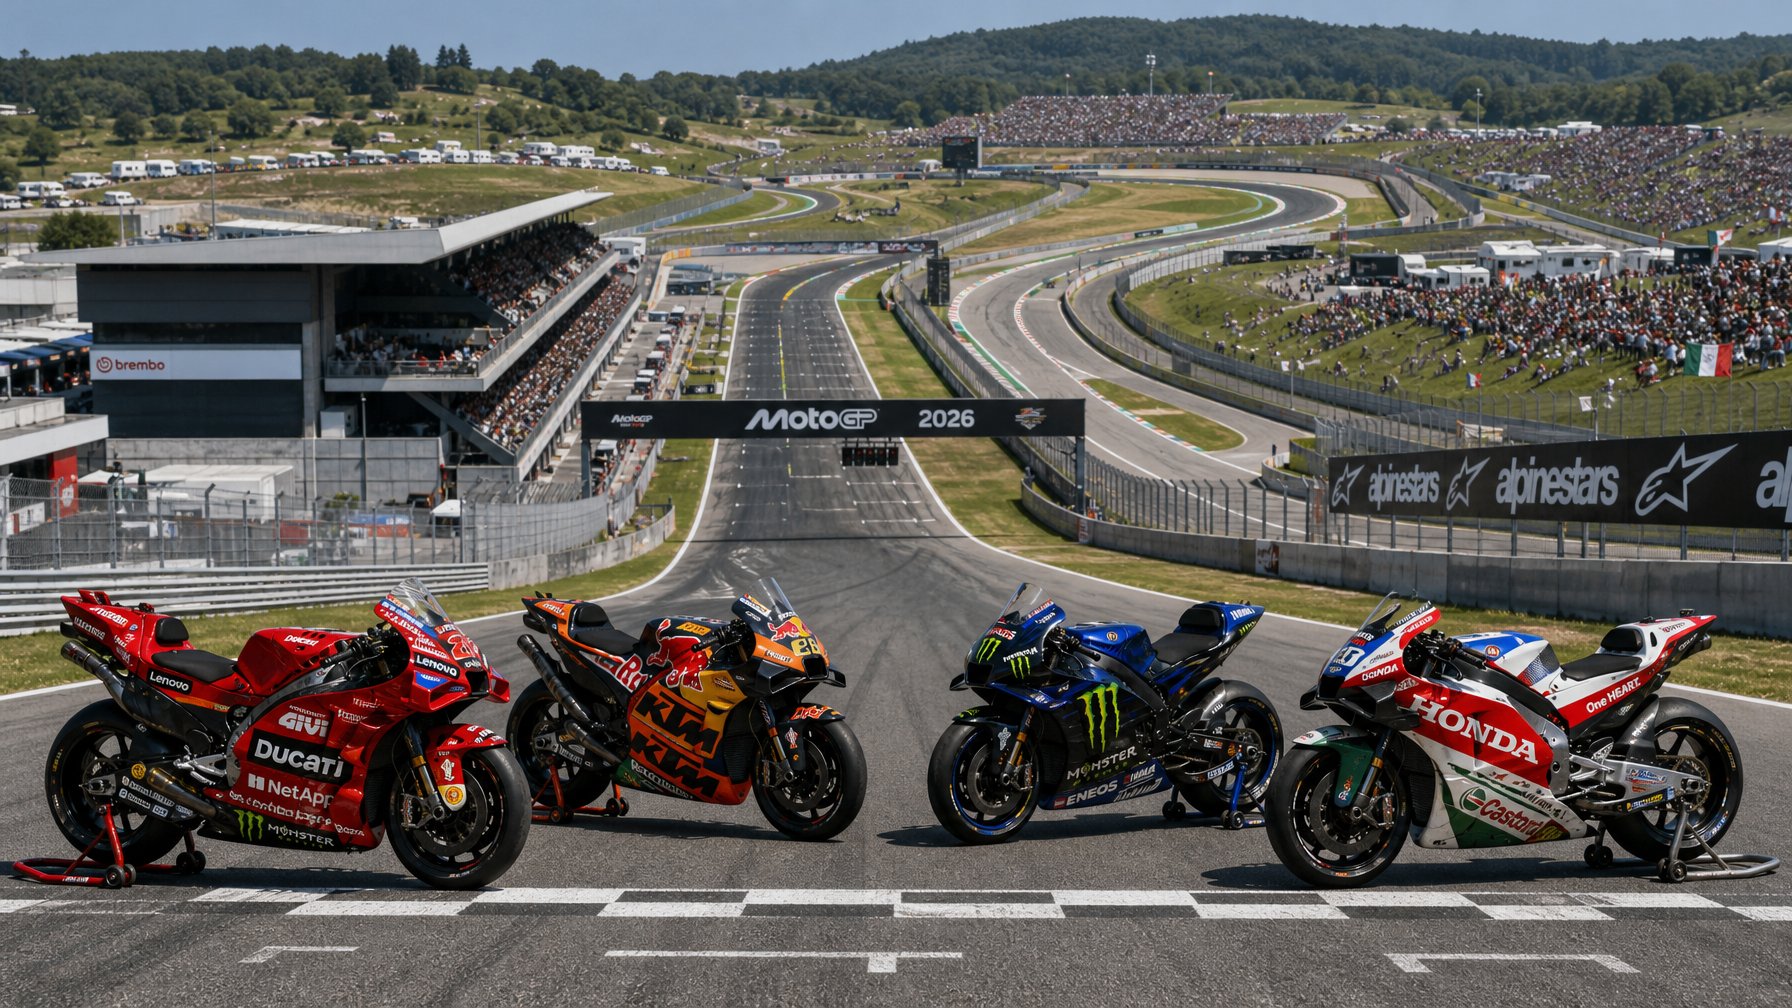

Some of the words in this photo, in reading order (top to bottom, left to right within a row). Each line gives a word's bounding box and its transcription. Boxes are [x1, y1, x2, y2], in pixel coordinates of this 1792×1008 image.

[115, 359, 165, 371] brembo
[744, 407, 877, 431] MotoGP
[918, 409, 975, 428] 2026
[1368, 463, 1440, 511] alpinestars
[1495, 456, 1620, 515] alpinestars
[416, 655, 457, 677] Lenovo
[149, 671, 189, 691] Lenovo
[1586, 698, 1607, 713] One
[635, 690, 720, 755] KTM
[1409, 693, 1539, 765] HONDA
[631, 731, 720, 798] KTM
[1066, 746, 1137, 780] MONSTER
[268, 779, 335, 808] NetApp
[1066, 780, 1118, 806] ENEOS
